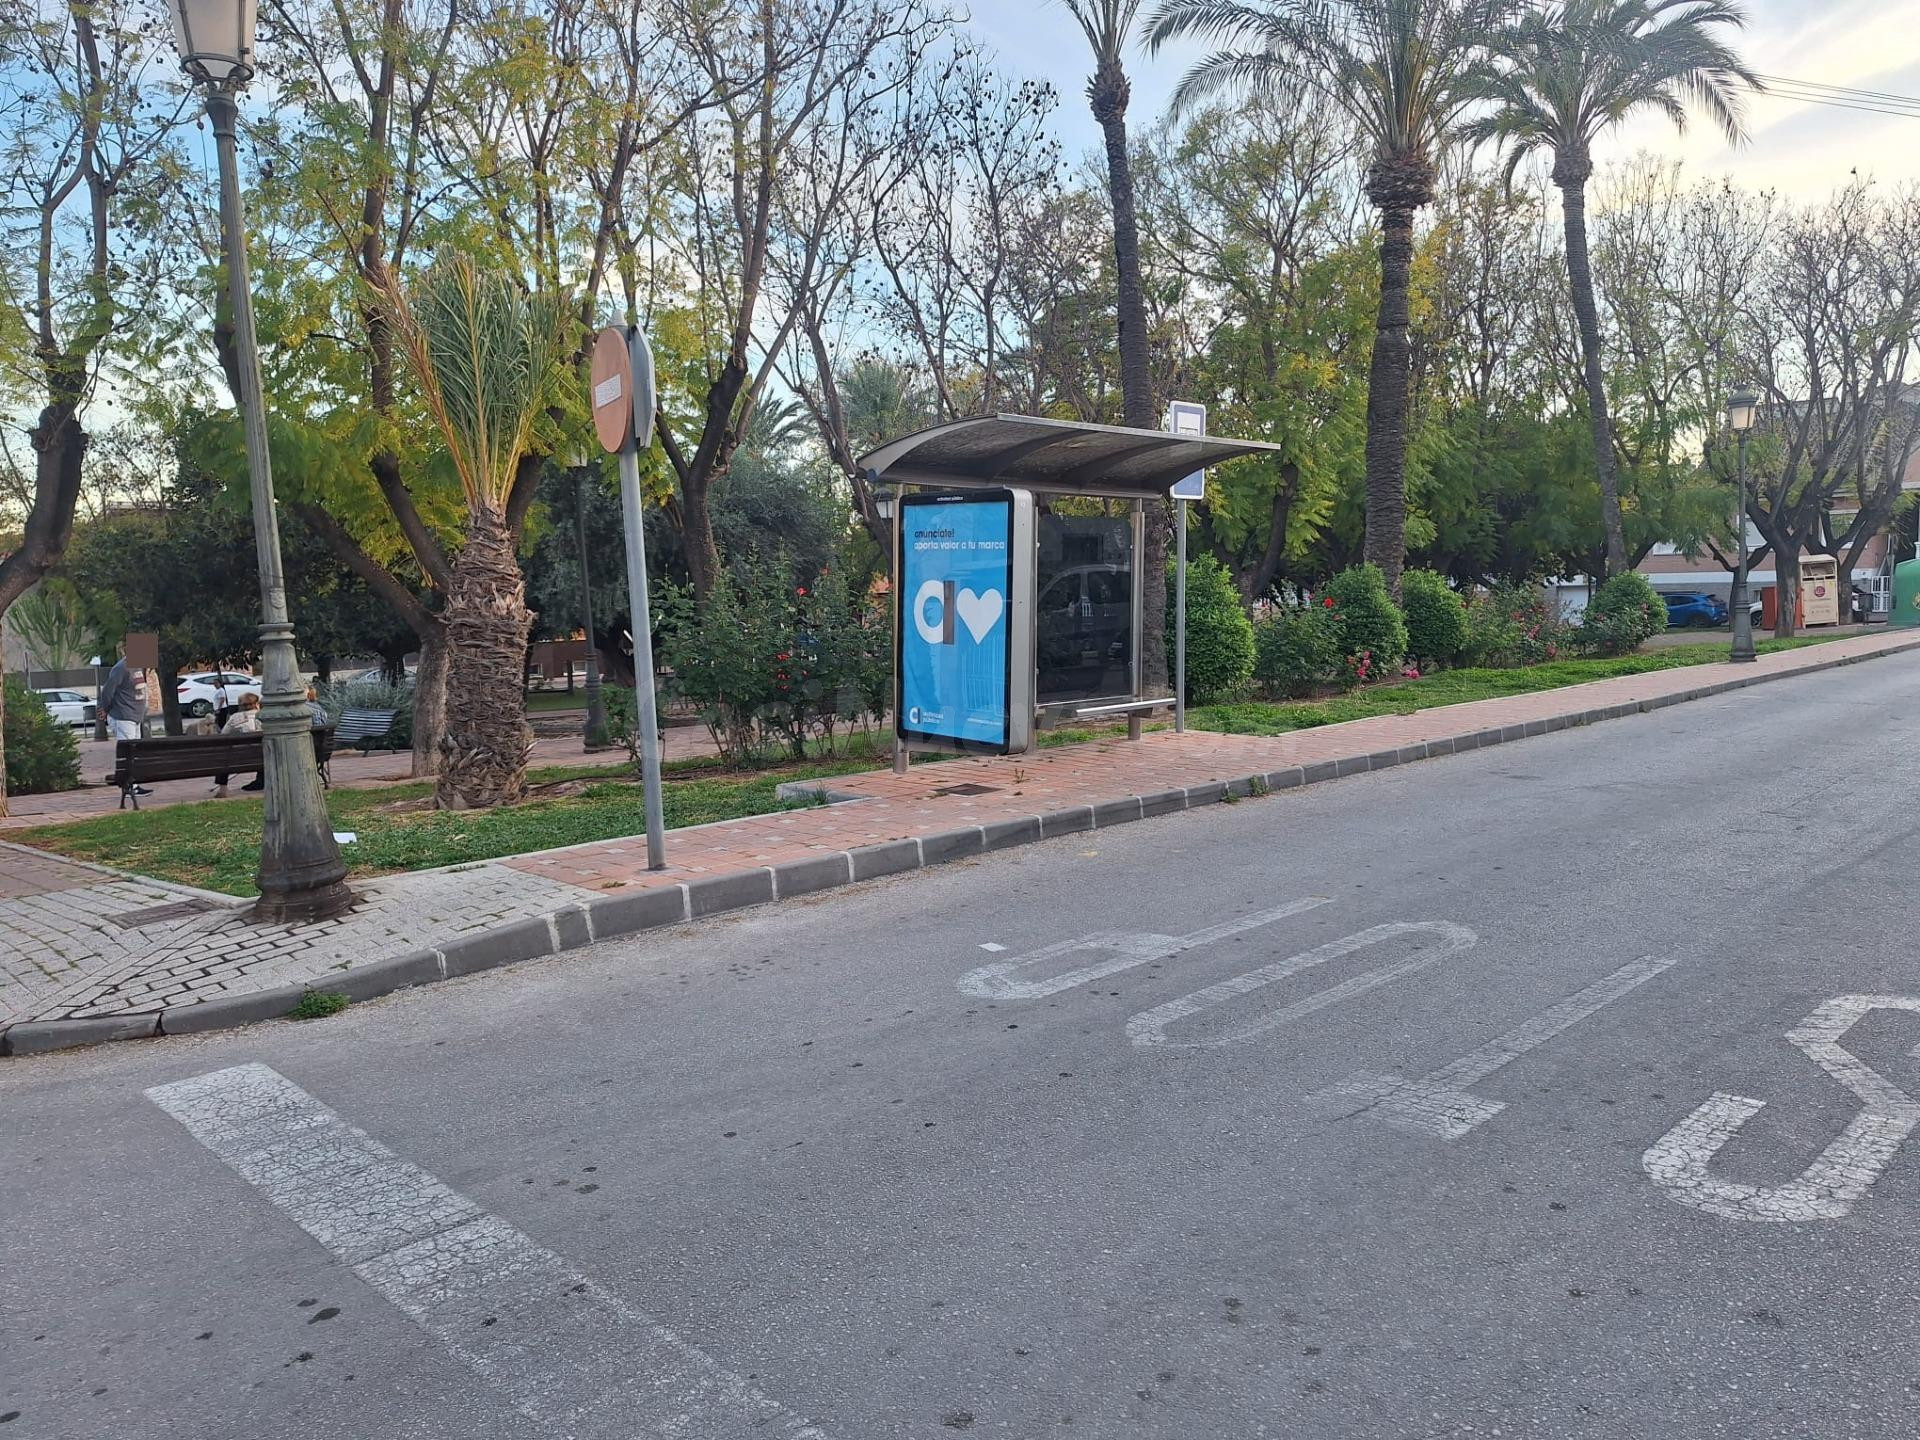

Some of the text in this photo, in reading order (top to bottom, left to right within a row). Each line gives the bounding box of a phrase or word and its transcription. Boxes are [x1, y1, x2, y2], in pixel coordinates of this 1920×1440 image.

[913, 540, 1005, 551] aporta valor a tu marca
[956, 893, 1920, 1223] STOP
